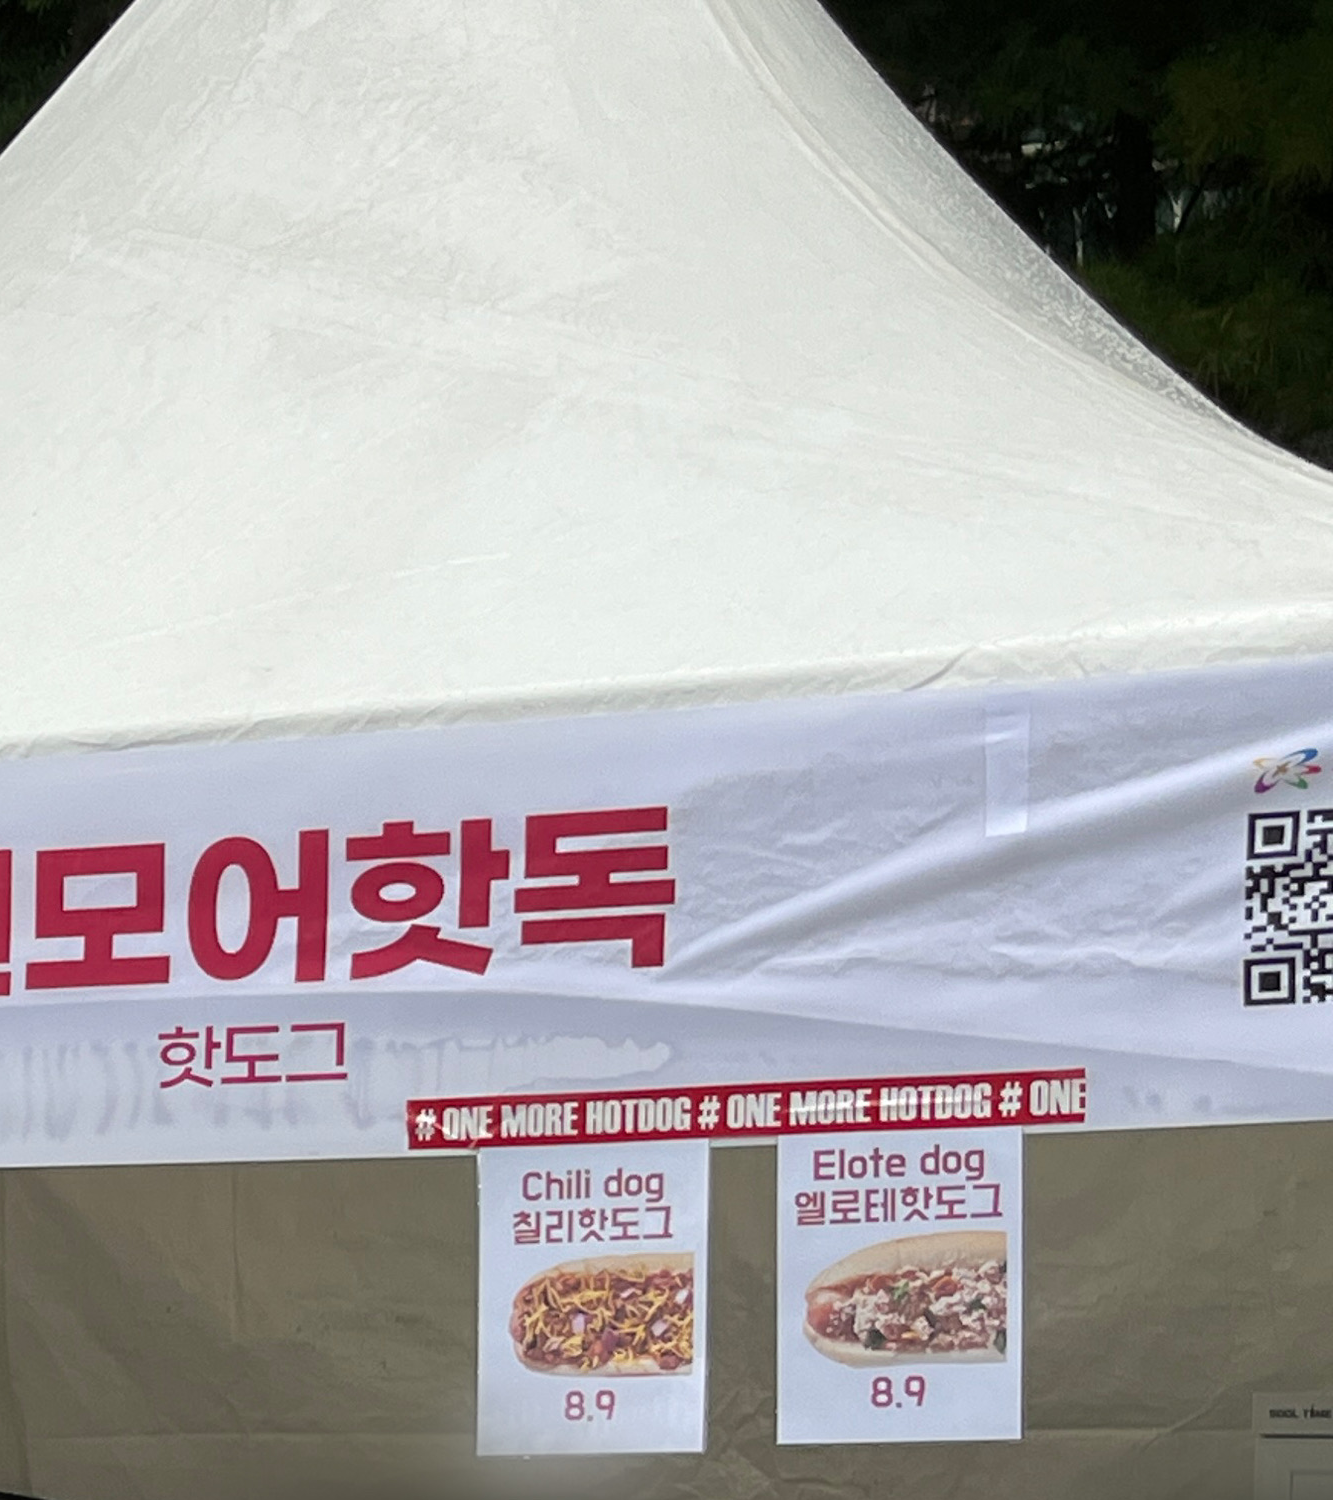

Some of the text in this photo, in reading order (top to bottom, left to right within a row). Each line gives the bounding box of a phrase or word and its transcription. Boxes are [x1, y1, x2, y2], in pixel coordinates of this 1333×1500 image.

[158, 1022, 350, 1088] 핫도그
[443, 1105, 493, 1140] ONE
[501, 1102, 579, 1138] MORE
[585, 1097, 691, 1135] HOTDOG
[727, 1092, 782, 1129] ONE
[789, 1088, 872, 1126] MORE
[880, 1082, 991, 1122] HOTDOG
[1030, 1078, 1086, 1116] ONE
[813, 1144, 985, 1181] Elote dog
[522, 1167, 664, 1202] Chili dog
[794, 1183, 1003, 1226] 엘로테핫도그
[513, 1206, 673, 1245] 칠리핫도그
[563, 1390, 616, 1421] 8.9
[870, 1376, 926, 1408] 8.9
